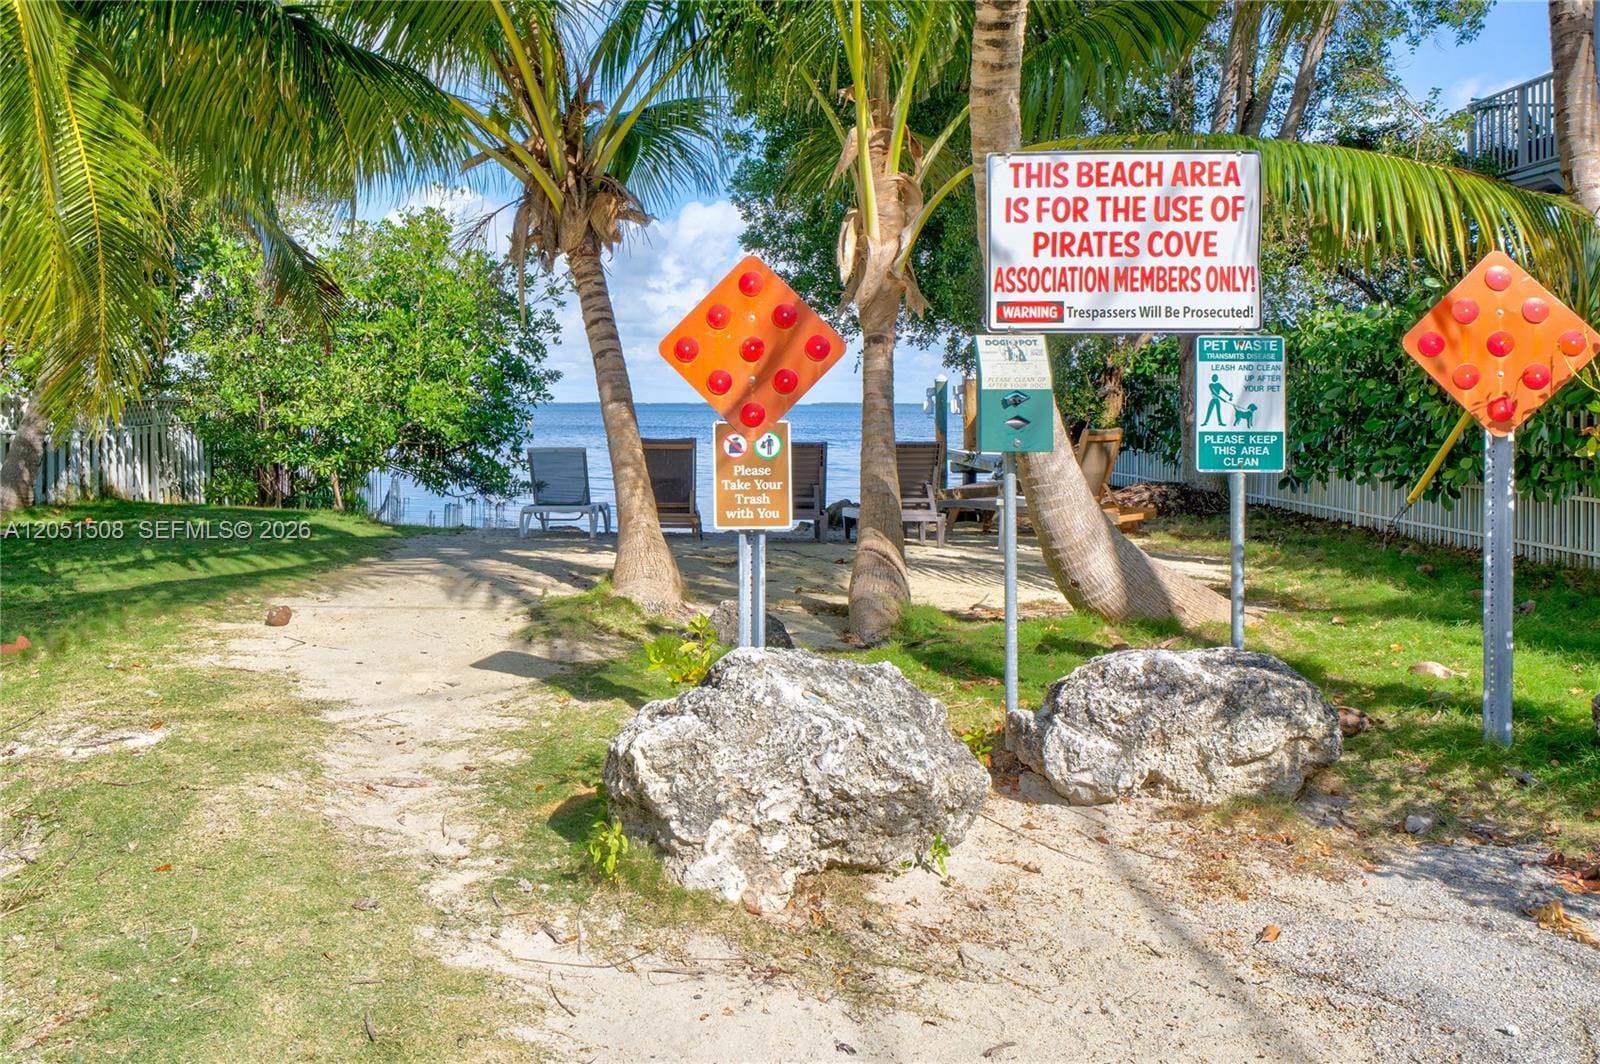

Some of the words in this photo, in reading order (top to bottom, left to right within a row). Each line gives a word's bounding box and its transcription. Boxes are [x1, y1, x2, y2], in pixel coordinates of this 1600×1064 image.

[1009, 161, 1069, 188] THIS
[1076, 161, 1164, 187] BEACH
[1170, 160, 1241, 187] AREA
[1005, 197, 1029, 223] IS
[1036, 197, 1088, 223] FOR
[1096, 196, 1146, 222] THE
[1153, 196, 1203, 222] USE
[1210, 196, 1245, 222] OF
[1032, 231, 1140, 258] PIRATES
[1147, 231, 1218, 257] COVE
[994, 266, 1109, 293] ASSOCIATION
[1114, 266, 1201, 293] MEMBERS
[1205, 266, 1256, 293] ONLY!
[1003, 306, 1058, 319] WARNING
[1066, 306, 1137, 320] Trespassers
[1139, 306, 1162, 318] Will
[1165, 306, 1180, 318] Be
[1183, 306, 1254, 318] Prosecuted!
[1203, 340, 1228, 351] PET
[1233, 340, 1278, 351] WASTE
[1204, 435, 1245, 444] PLEASE
[1249, 435, 1278, 444] KEEP
[1212, 446, 1237, 455] THIS
[1241, 446, 1270, 455] AREA
[1223, 457, 1259, 467] CLEAN
[733, 465, 771, 476] Please
[721, 479, 751, 490] Take
[753, 479, 783, 490] Your
[734, 494, 771, 505] Trash
[725, 508, 754, 519] with
[756, 508, 780, 519] You
